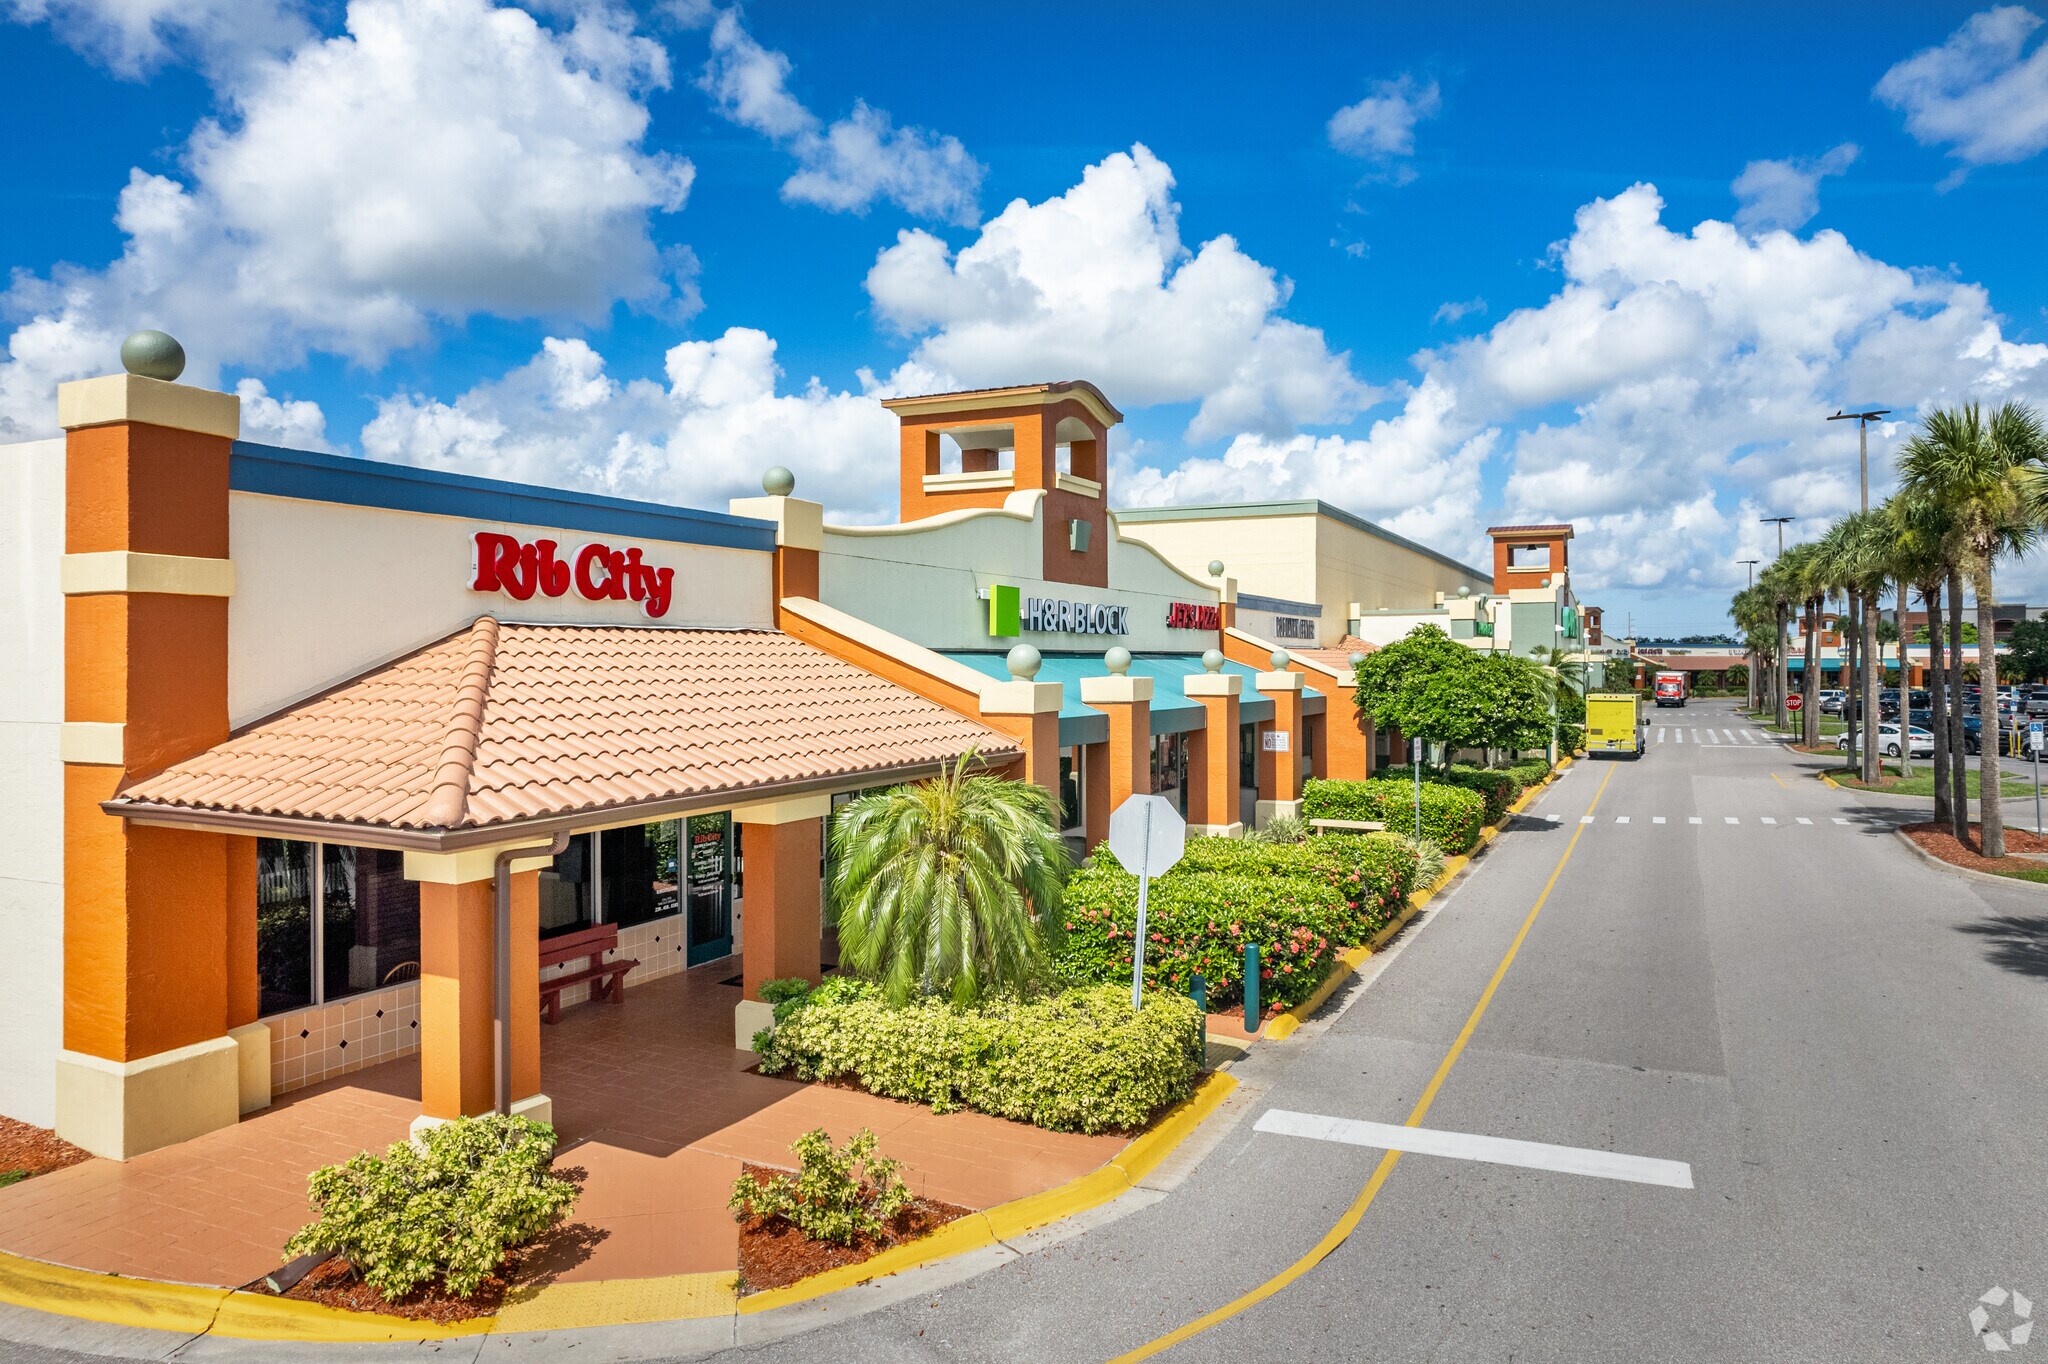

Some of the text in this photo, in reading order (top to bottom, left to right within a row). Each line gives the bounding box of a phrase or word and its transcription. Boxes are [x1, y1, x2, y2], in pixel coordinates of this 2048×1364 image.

[468, 532, 675, 618] Rib City
[1027, 597, 1129, 635] H&R BLOCK
[694, 832, 721, 844] Rib City
